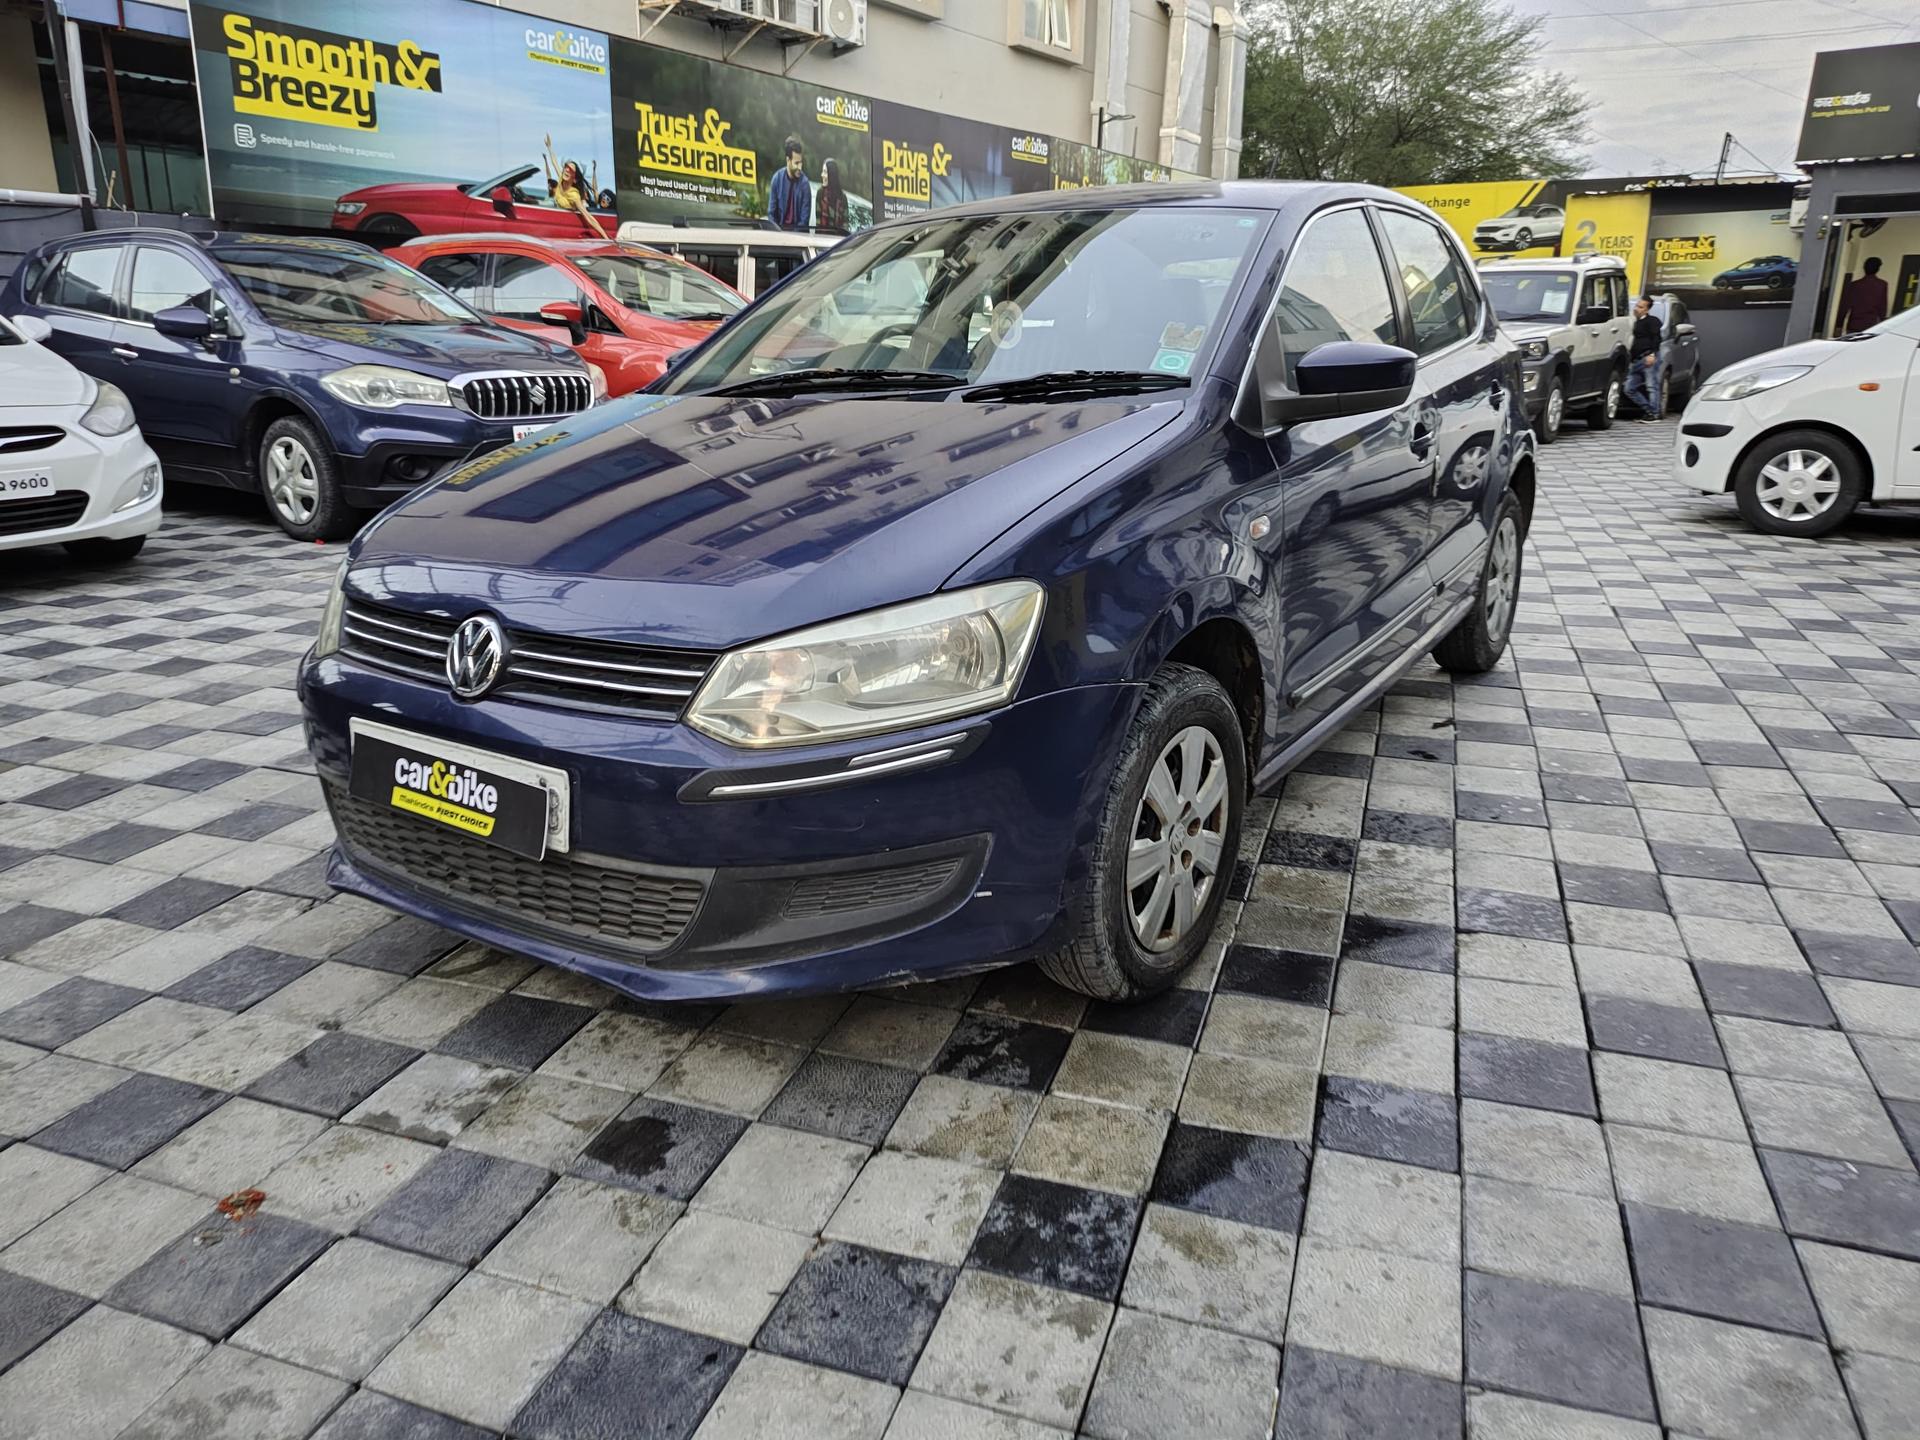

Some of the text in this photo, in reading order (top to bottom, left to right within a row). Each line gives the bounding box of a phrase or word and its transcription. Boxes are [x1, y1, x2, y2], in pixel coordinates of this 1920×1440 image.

[222, 13, 441, 92] Smooth &
[525, 28, 606, 64] car&bike
[229, 57, 377, 129] Breezy
[816, 95, 869, 122] car&bike
[634, 101, 731, 148] Trust &
[260, 133, 293, 148] Speedy
[294, 138, 310, 149] and
[1011, 135, 1049, 157] car&bike
[639, 133, 754, 178] Assurance
[882, 139, 953, 177] Drive &
[640, 175, 656, 186] Most
[656, 178, 673, 188] loved
[673, 180, 688, 190] Used
[689, 182, 699, 192] Car
[699, 183, 716, 195] brand
[722, 187, 737, 198] India
[883, 166, 928, 196] Smile
[654, 188, 682, 200] Franchise
[699, 194, 707, 203] ET
[1575, 220, 1597, 249] 2
[1599, 235, 1634, 249] YEARS
[1661, 249, 1715, 261] On-road
[9, 476, 49, 491] 9600
[394, 756, 499, 814] car&bike
[435, 806, 460, 821] FIRST
[459, 814, 490, 831] CHOICE
